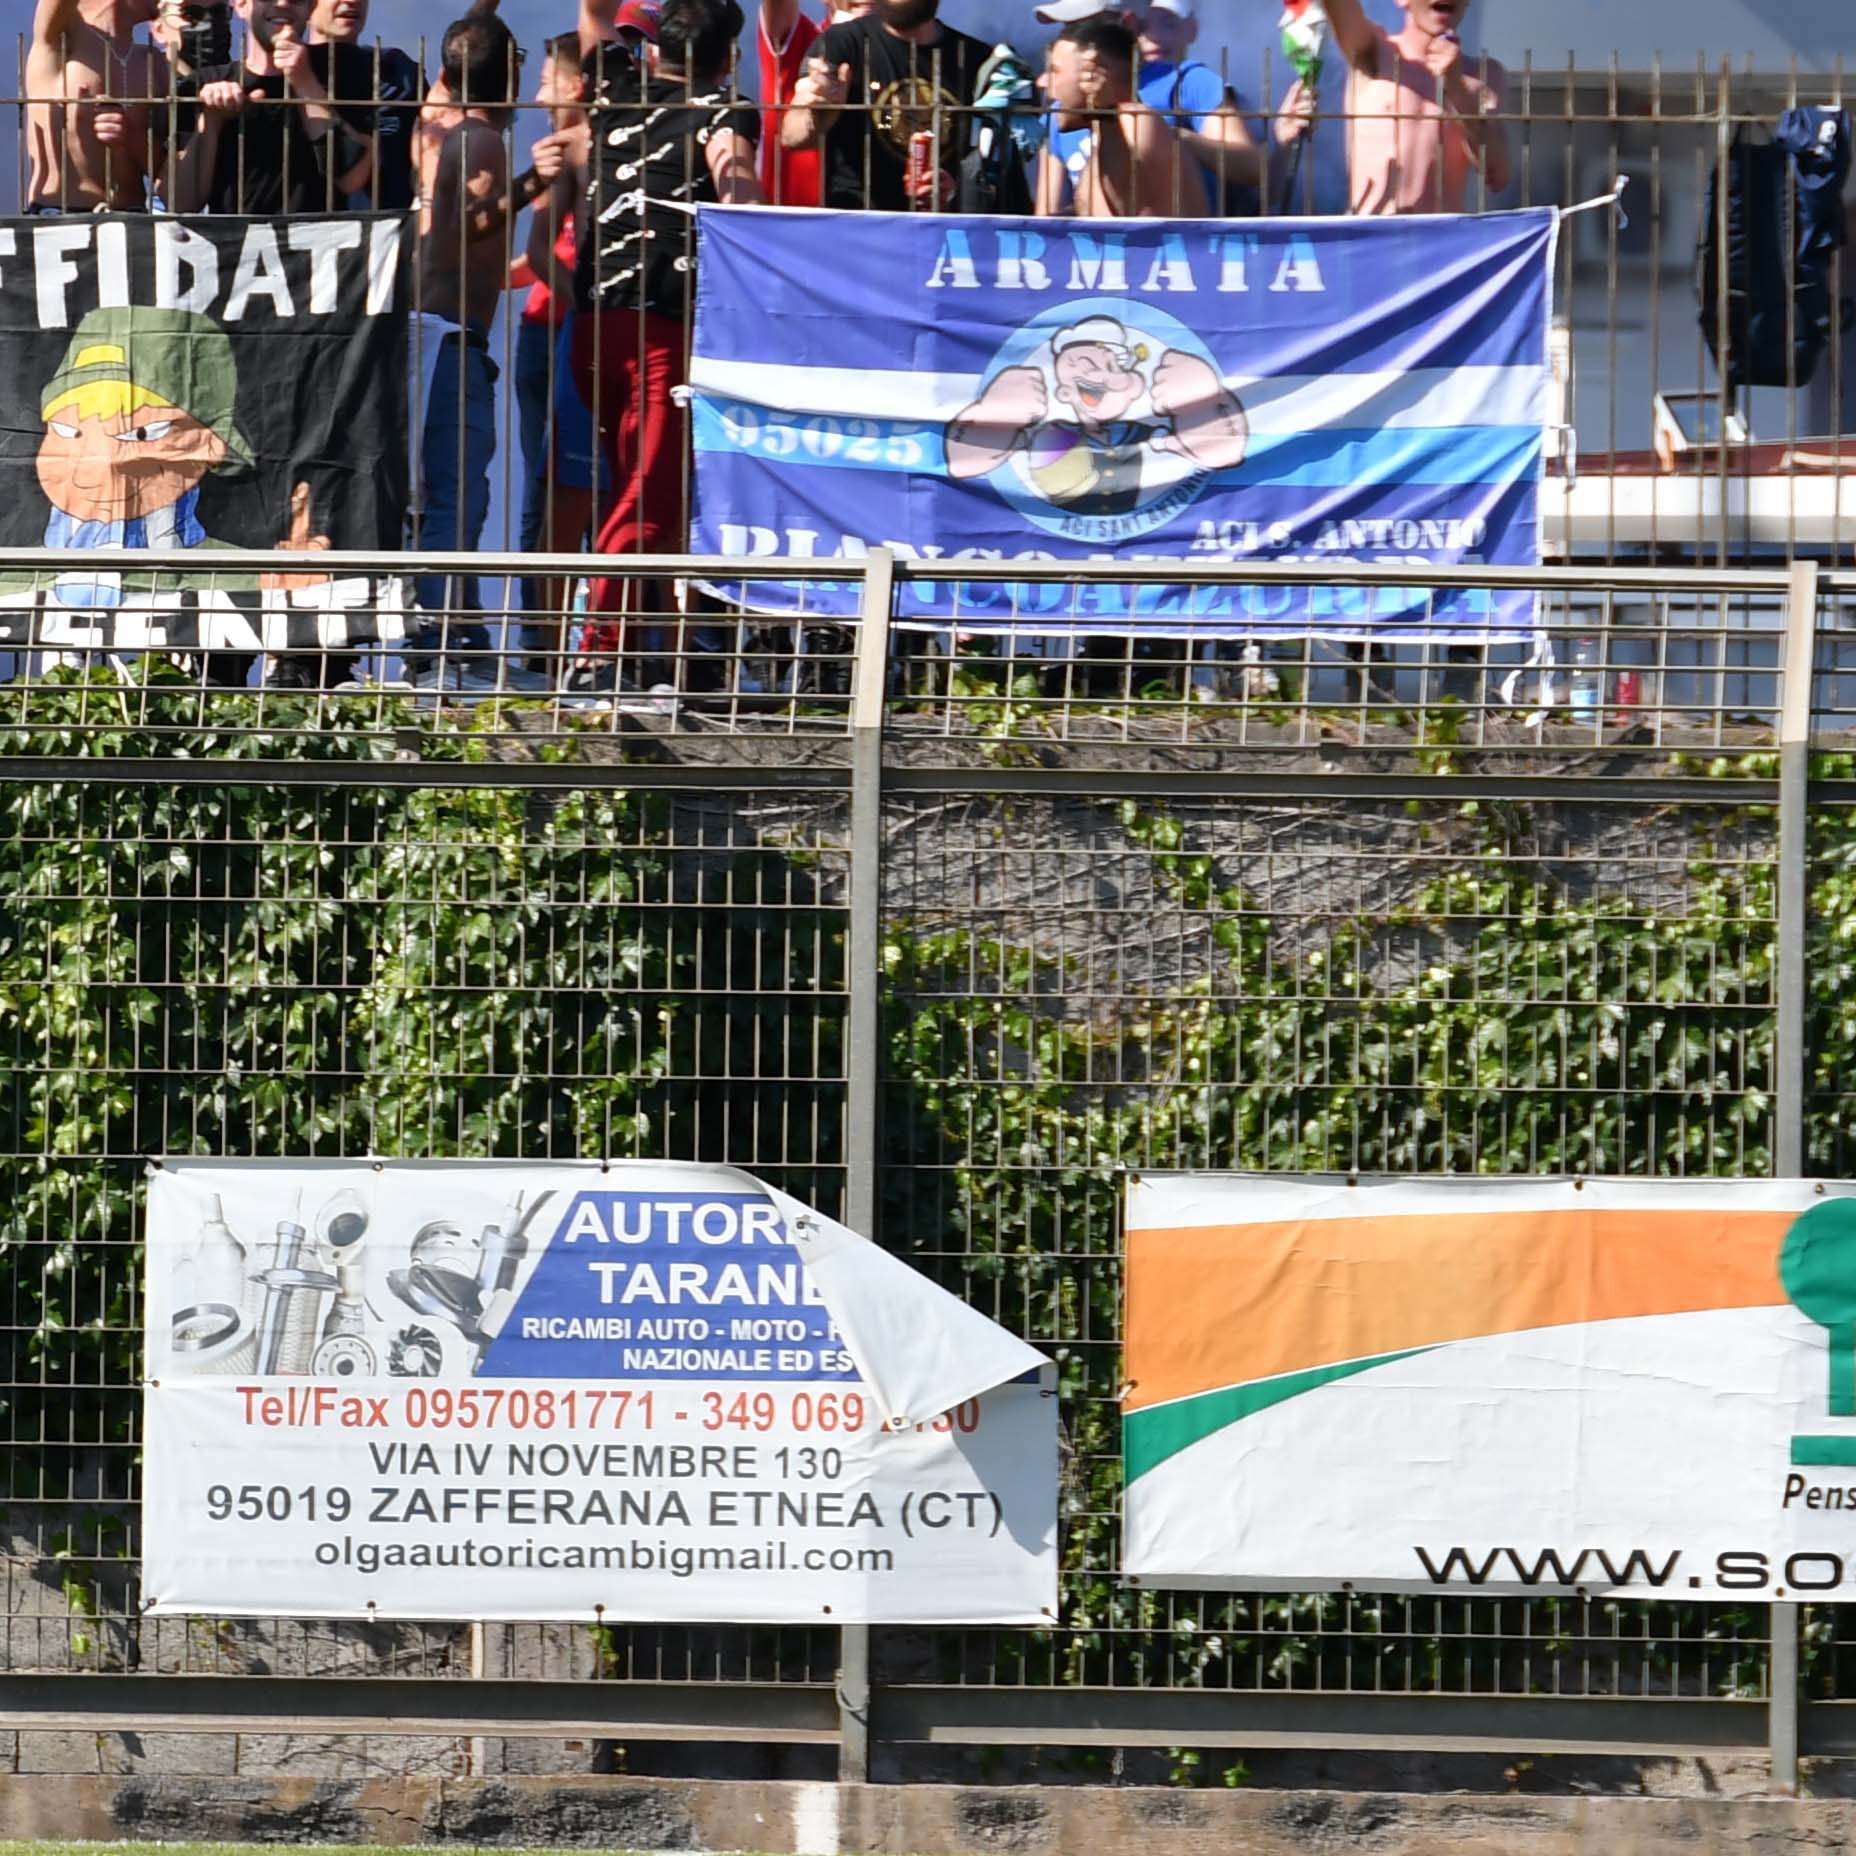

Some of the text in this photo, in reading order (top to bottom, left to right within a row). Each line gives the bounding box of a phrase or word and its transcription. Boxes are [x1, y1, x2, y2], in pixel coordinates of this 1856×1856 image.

[925, 229, 1326, 292] ARMATA
[720, 404, 923, 466] 95025
[1190, 520, 1262, 551] ACI
[1312, 519, 1485, 550] ANTONIO
[565, 1201, 797, 1245] AUTOR
[522, 1317, 631, 1341] RICAMBI
[636, 1318, 711, 1341] AUTO
[731, 1319, 807, 1342] MOTO
[623, 1349, 772, 1372] NAZIONALE
[777, 1350, 814, 1372] ED
[236, 1386, 390, 1428] Tel/Fax
[405, 1388, 654, 1430] 0957081771
[702, 1391, 775, 1432] 349
[791, 1391, 865, 1433] 069
[369, 1441, 843, 1480] VIA IV NOVEMBRE 130
[206, 1484, 1004, 1538] 95019 ZAFFERANA ETNEA (CT)
[314, 1535, 894, 1577] olgaautoricambigmail.com
